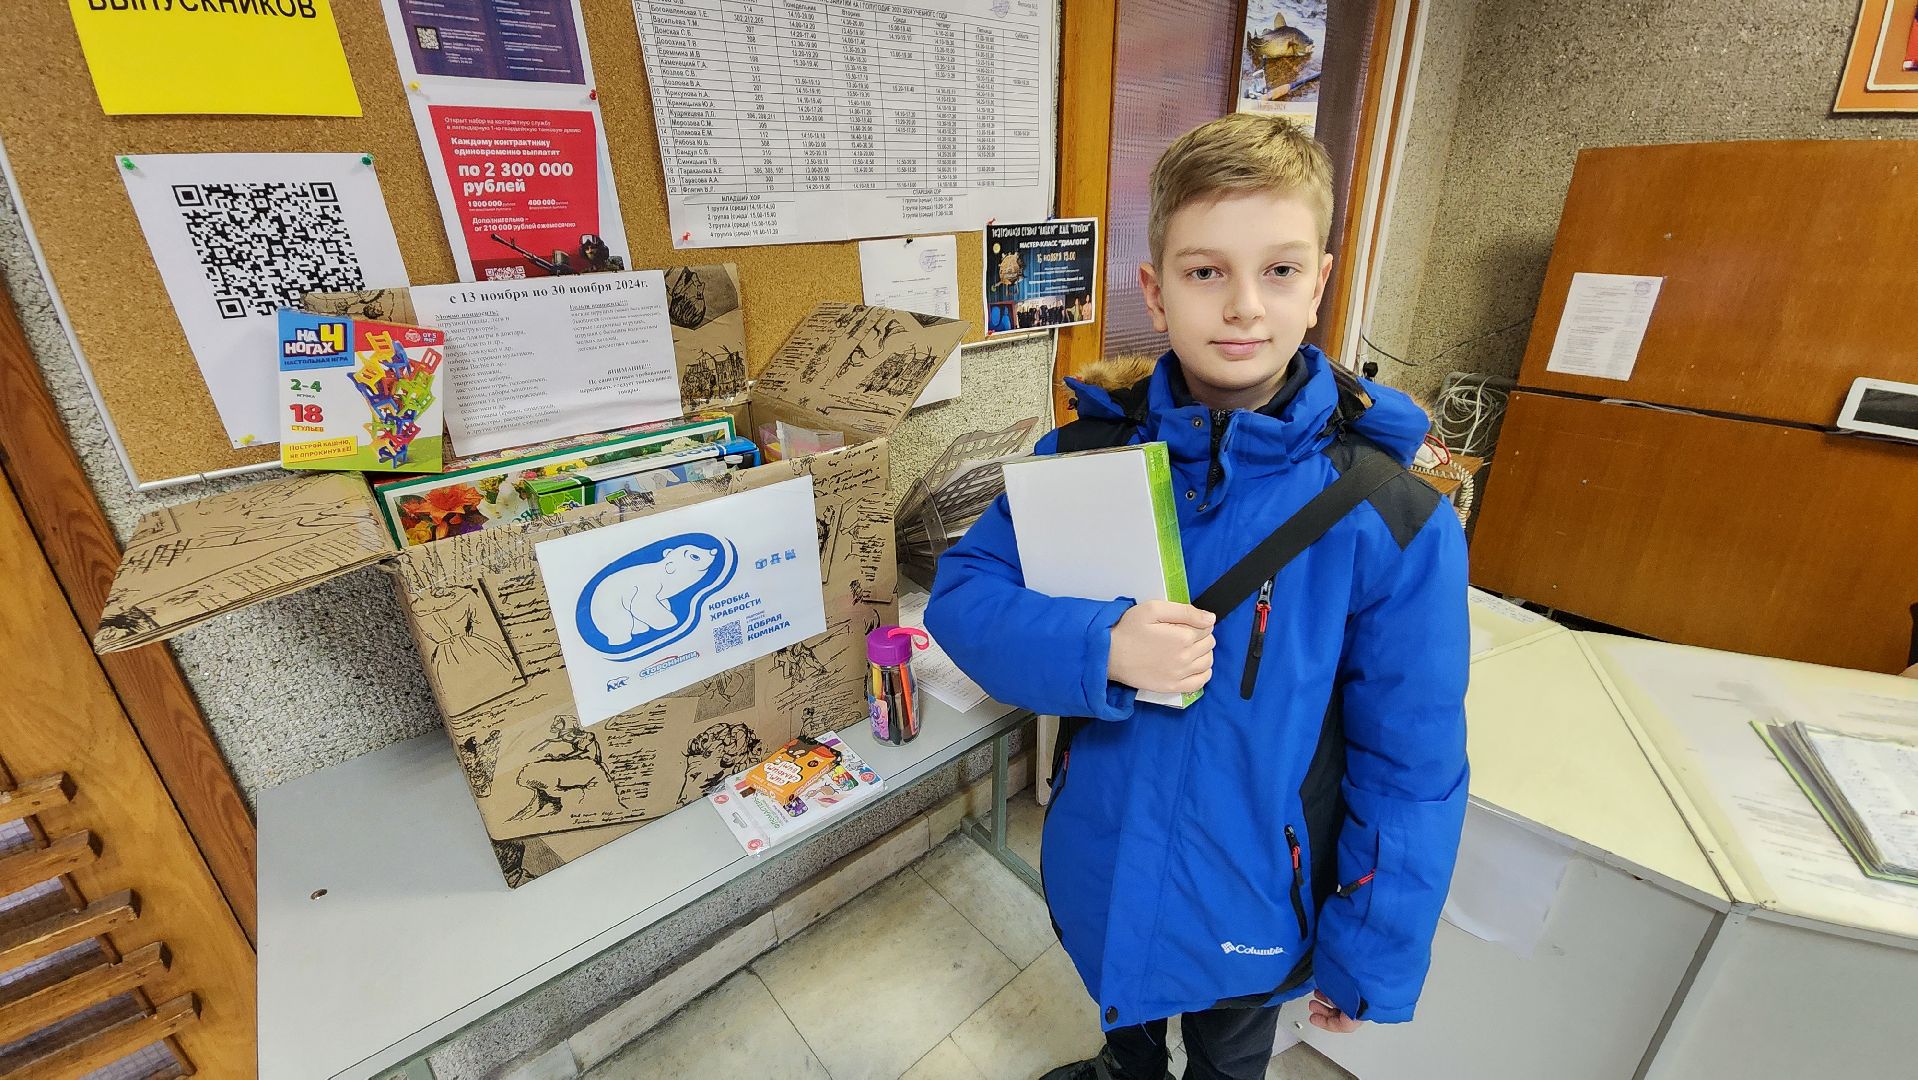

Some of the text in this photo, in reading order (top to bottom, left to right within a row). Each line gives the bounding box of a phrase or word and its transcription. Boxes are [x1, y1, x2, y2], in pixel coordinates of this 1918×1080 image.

[652, 16, 686, 26] Васильева
[444, 117, 467, 125] Открыт
[468, 118, 486, 126] набор
[494, 119, 530, 127] контрактную
[671, 119, 700, 127] Морозова
[451, 137, 551, 149] Каждому контрактнику
[454, 148, 561, 158] единовременно выплатят
[459, 162, 574, 177] по 2 300 000
[463, 178, 526, 196] рублей
[473, 217, 525, 225] Дополнительно
[1019, 240, 1058, 249] МАСТЕР-КЛАСС
[450, 278, 649, 304] с 13 ноября по 30 ноября 2024г.
[296, 322, 345, 352] НА 4
[284, 340, 335, 356] НОГАХ
[284, 357, 330, 366] НАСТОЛЬНАЯ
[290, 378, 323, 393] 2-4
[289, 404, 324, 423] 18
[708, 592, 750, 612] КОРОБКА
[710, 598, 762, 622] ХРАБРОСТИ
[746, 613, 783, 633] ДОБРАЯ
[747, 620, 791, 642] КОМНАТА
[640, 652, 697, 677] СТОРОННИКИ
[1235, 944, 1284, 956] Columbia
